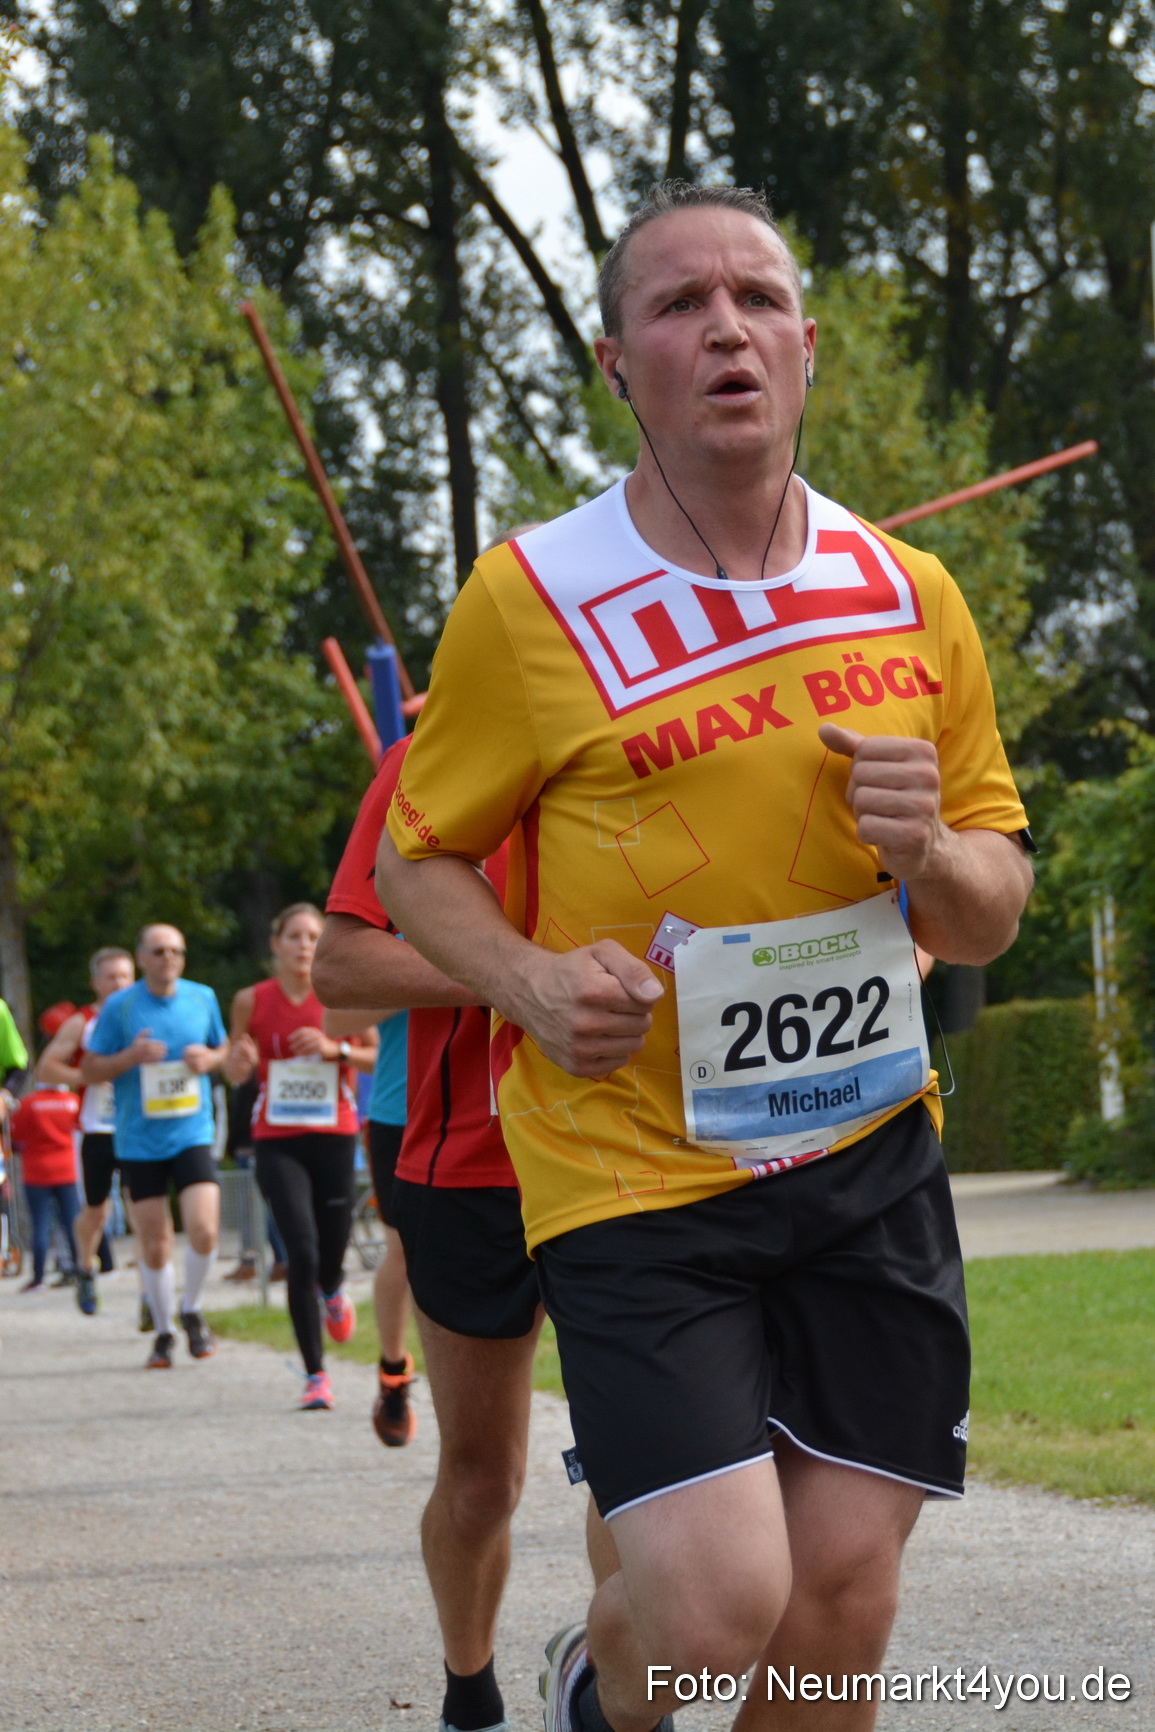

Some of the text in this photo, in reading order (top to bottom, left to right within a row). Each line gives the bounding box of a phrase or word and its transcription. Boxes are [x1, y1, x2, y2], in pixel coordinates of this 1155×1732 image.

[621, 651, 943, 780] MAX BÖGL
[778, 929, 860, 963] BOCK
[779, 961, 805, 971] inspired
[816, 956, 834, 964] smart
[835, 950, 862, 960] concepts
[721, 975, 890, 1072] 2622
[278, 1079, 327, 1099] 2050
[697, 1066, 707, 1079] D
[768, 1076, 862, 1118] Michael
